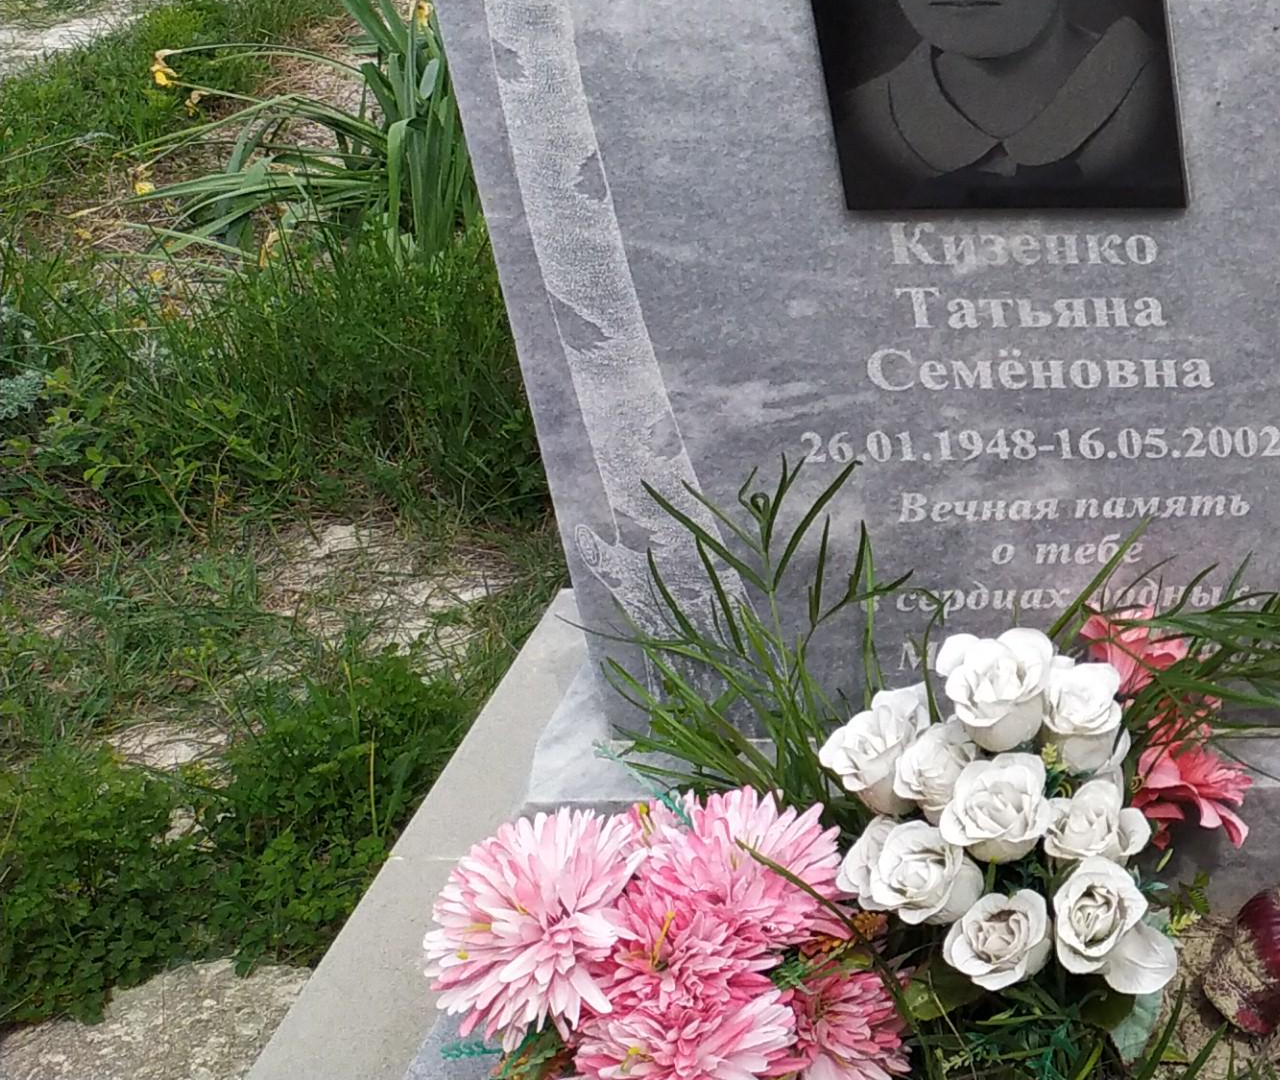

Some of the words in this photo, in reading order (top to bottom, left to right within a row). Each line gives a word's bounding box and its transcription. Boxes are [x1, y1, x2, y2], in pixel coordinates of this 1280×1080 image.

[890, 221, 1159, 265] Кизенко
[895, 287, 1168, 329] Татьяна
[866, 347, 1215, 392] Семёновна
[899, 492, 1059, 522] Вечная
[1073, 492, 1251, 520] память
[991, 542, 1015, 565] о
[1035, 534, 1144, 565] тебе
